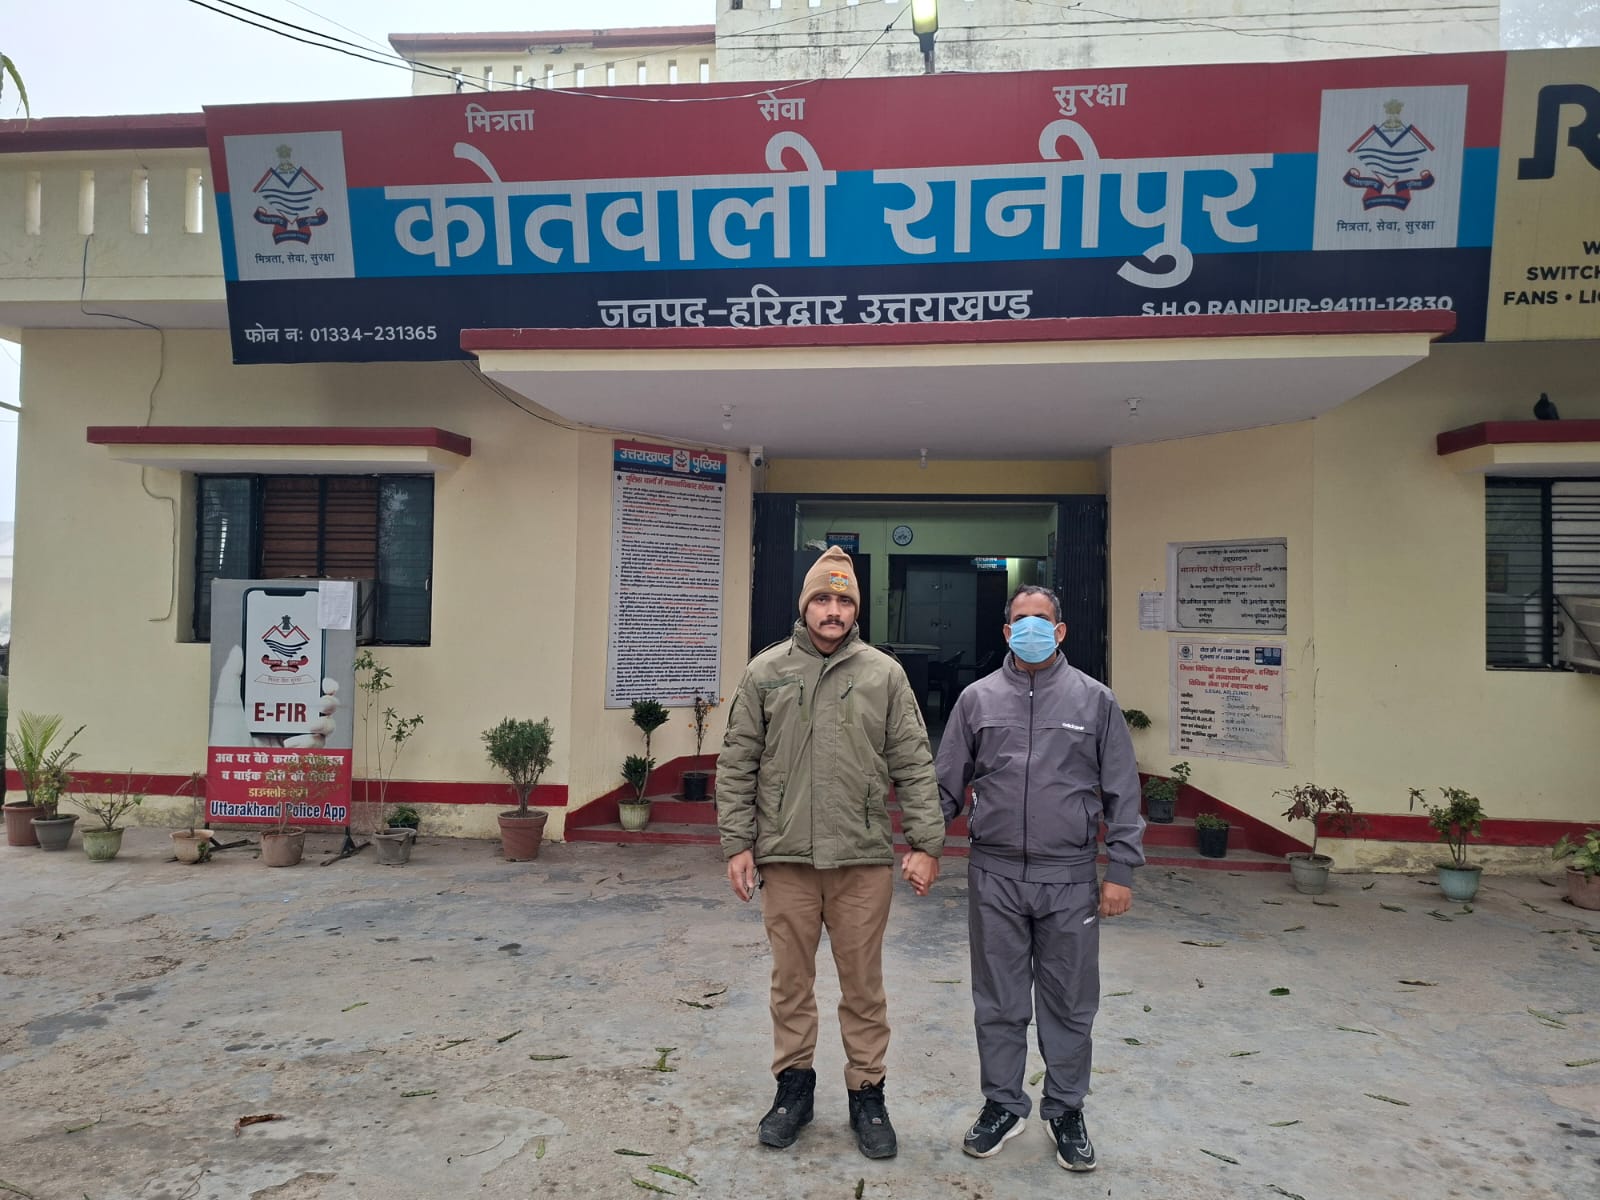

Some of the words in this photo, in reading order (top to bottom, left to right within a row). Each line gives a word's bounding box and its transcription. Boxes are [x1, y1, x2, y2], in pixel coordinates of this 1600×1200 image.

[757, 91, 806, 121] सेवा
[1052, 83, 1128, 116] सुरक्षा
[465, 103, 535, 133] मित्रता
[384, 131, 837, 267] कोतवाली
[873, 119, 1274, 289] रानीपुर
[1405, 221, 1435, 234] सुरक्षा
[310, 253, 335, 266] सुरक्षा
[1503, 291, 1558, 305] FANS
[1579, 289, 1600, 304] LI
[858, 290, 1033, 325] उत्तराखण्ड
[245, 323, 279, 343] फोन
[311, 326, 437, 342] 01334-231365
[619, 448, 672, 465] उत्तराखण्ड
[692, 454, 721, 473] पुलिस
[254, 702, 307, 722] E-FIR
[215, 753, 233, 763] अब
[237, 753, 251, 763] घर
[254, 752, 270, 763] बैठे
[221, 770, 230, 780] व
[248, 786, 286, 798] डाउनलोड
[211, 801, 282, 818] Uttarakhand
[286, 803, 320, 818] Police
[323, 804, 346, 821] App
